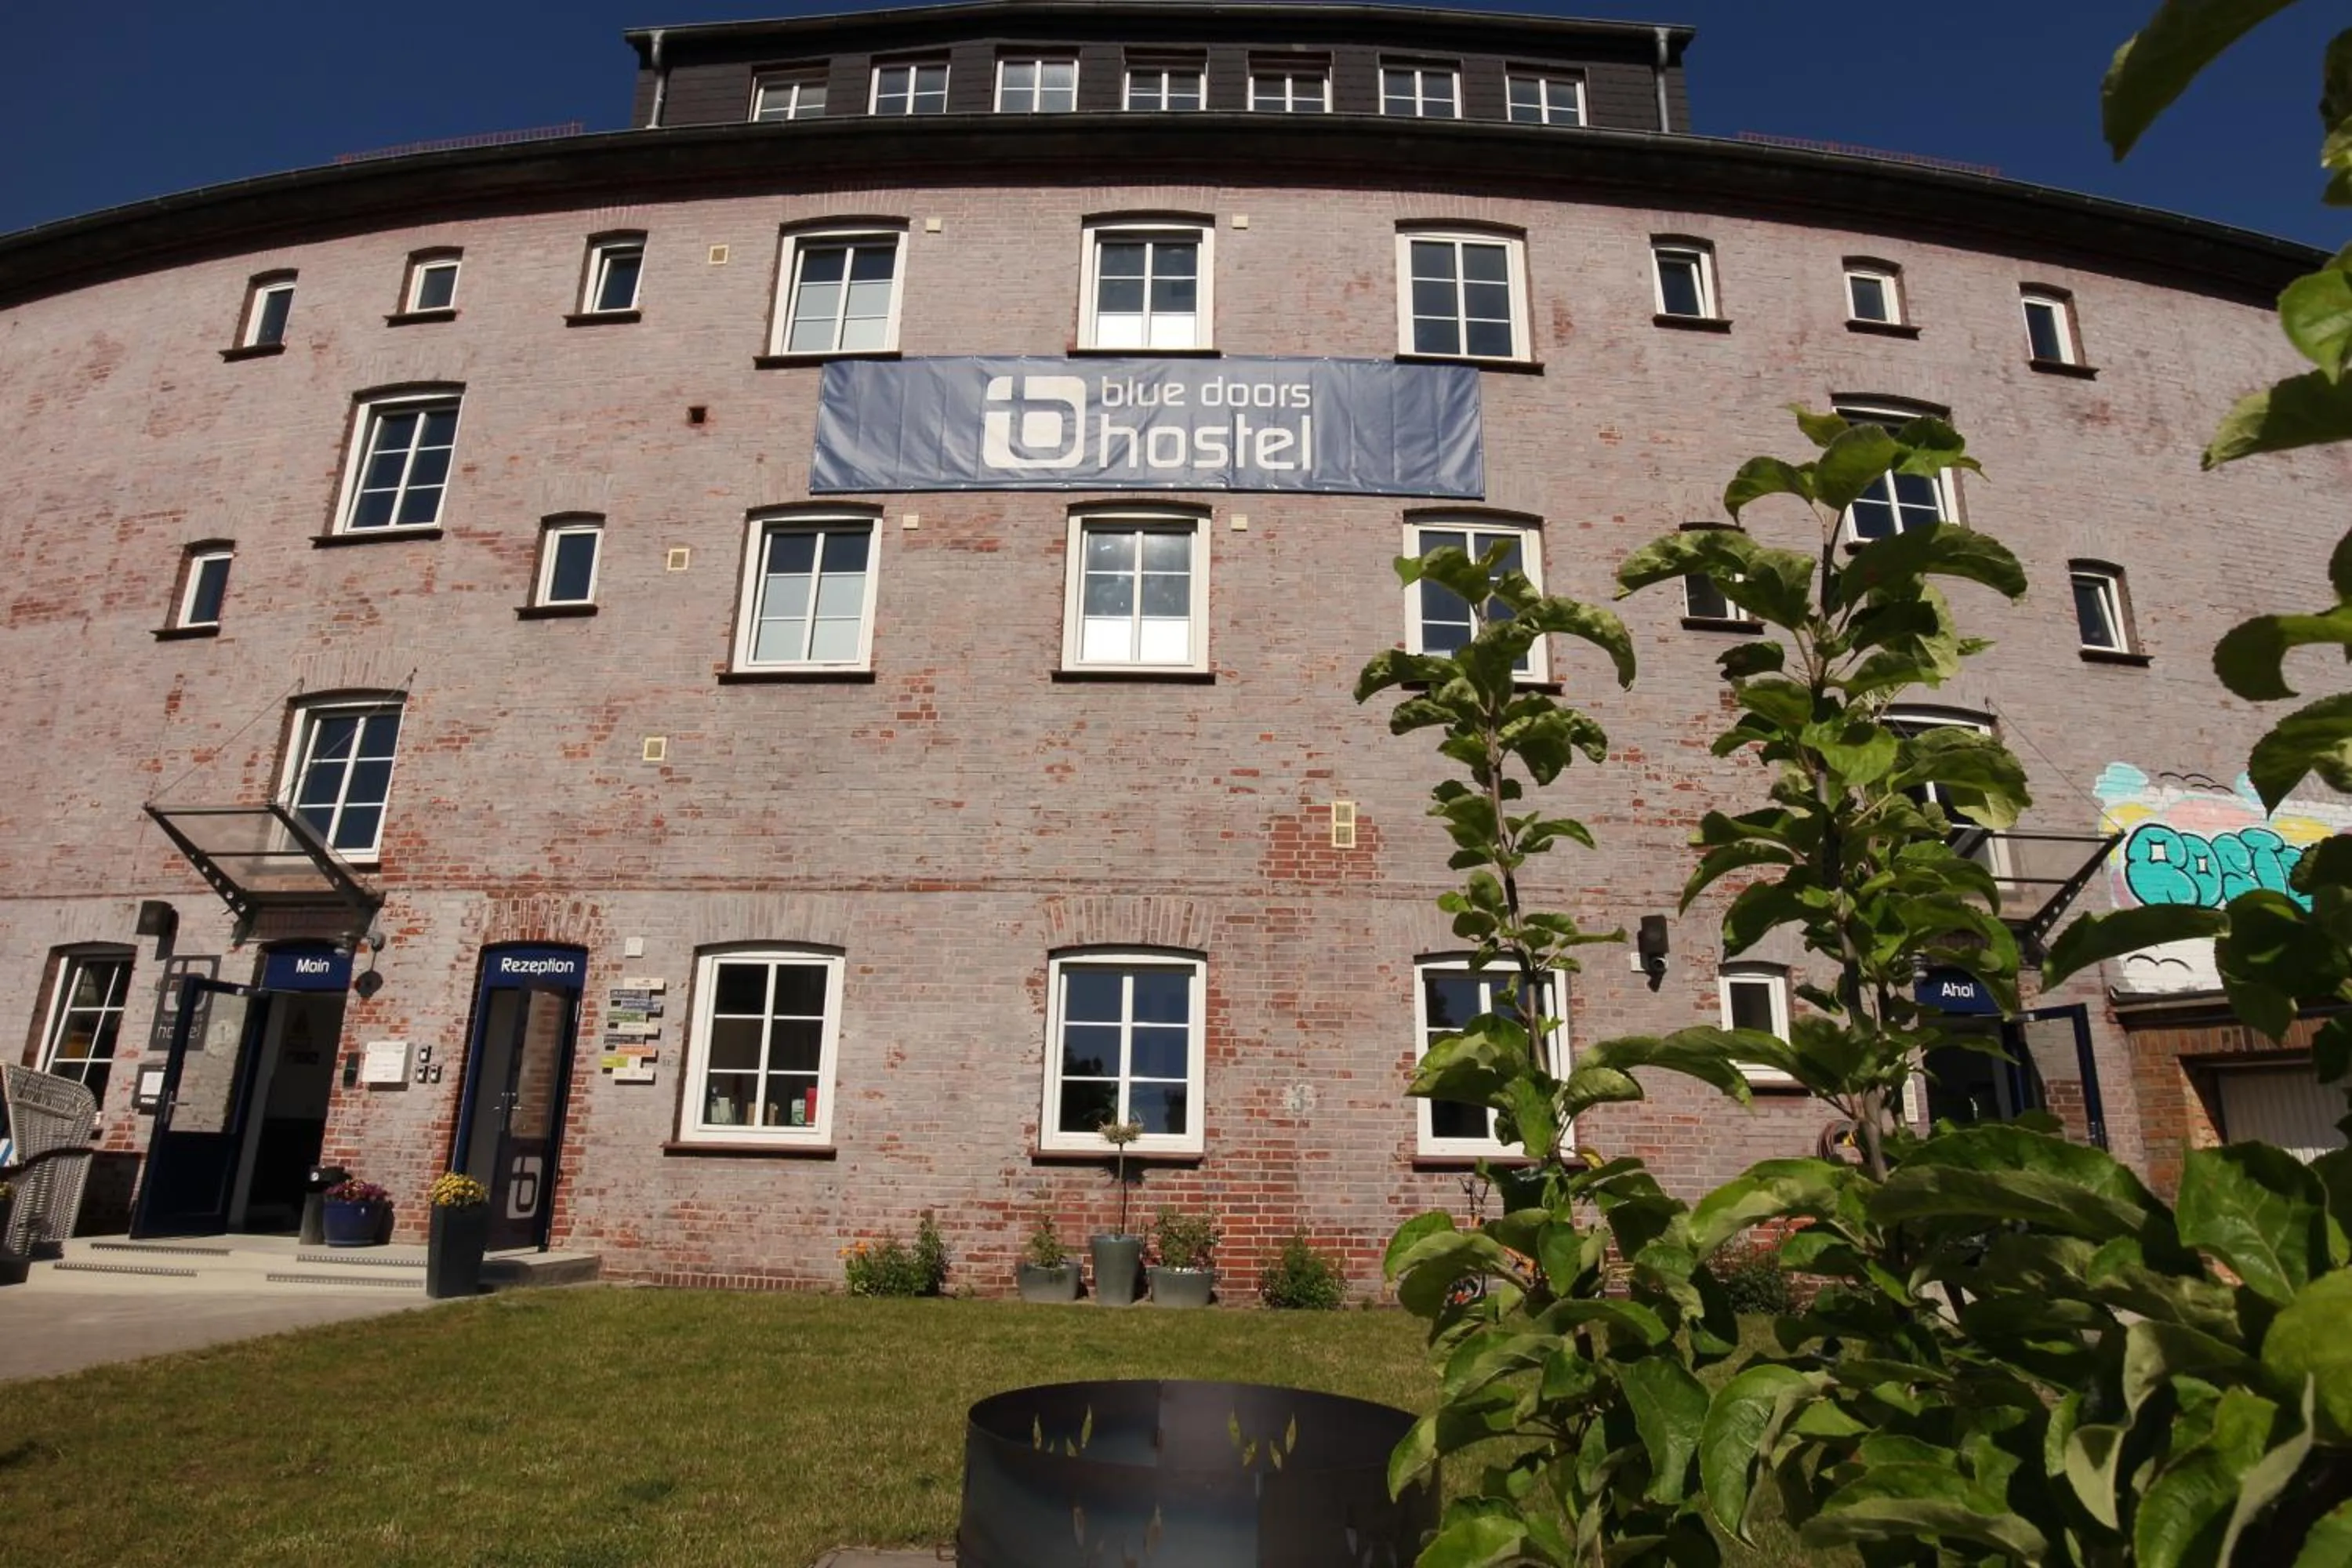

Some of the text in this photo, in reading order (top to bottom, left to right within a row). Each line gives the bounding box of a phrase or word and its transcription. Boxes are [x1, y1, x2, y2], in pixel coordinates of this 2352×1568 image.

[1102, 376, 1311, 408] blue doors
[1099, 413, 1312, 470] hostel
[501, 957, 575, 976] Rezeption
[1941, 982, 1975, 998] Ahoi
